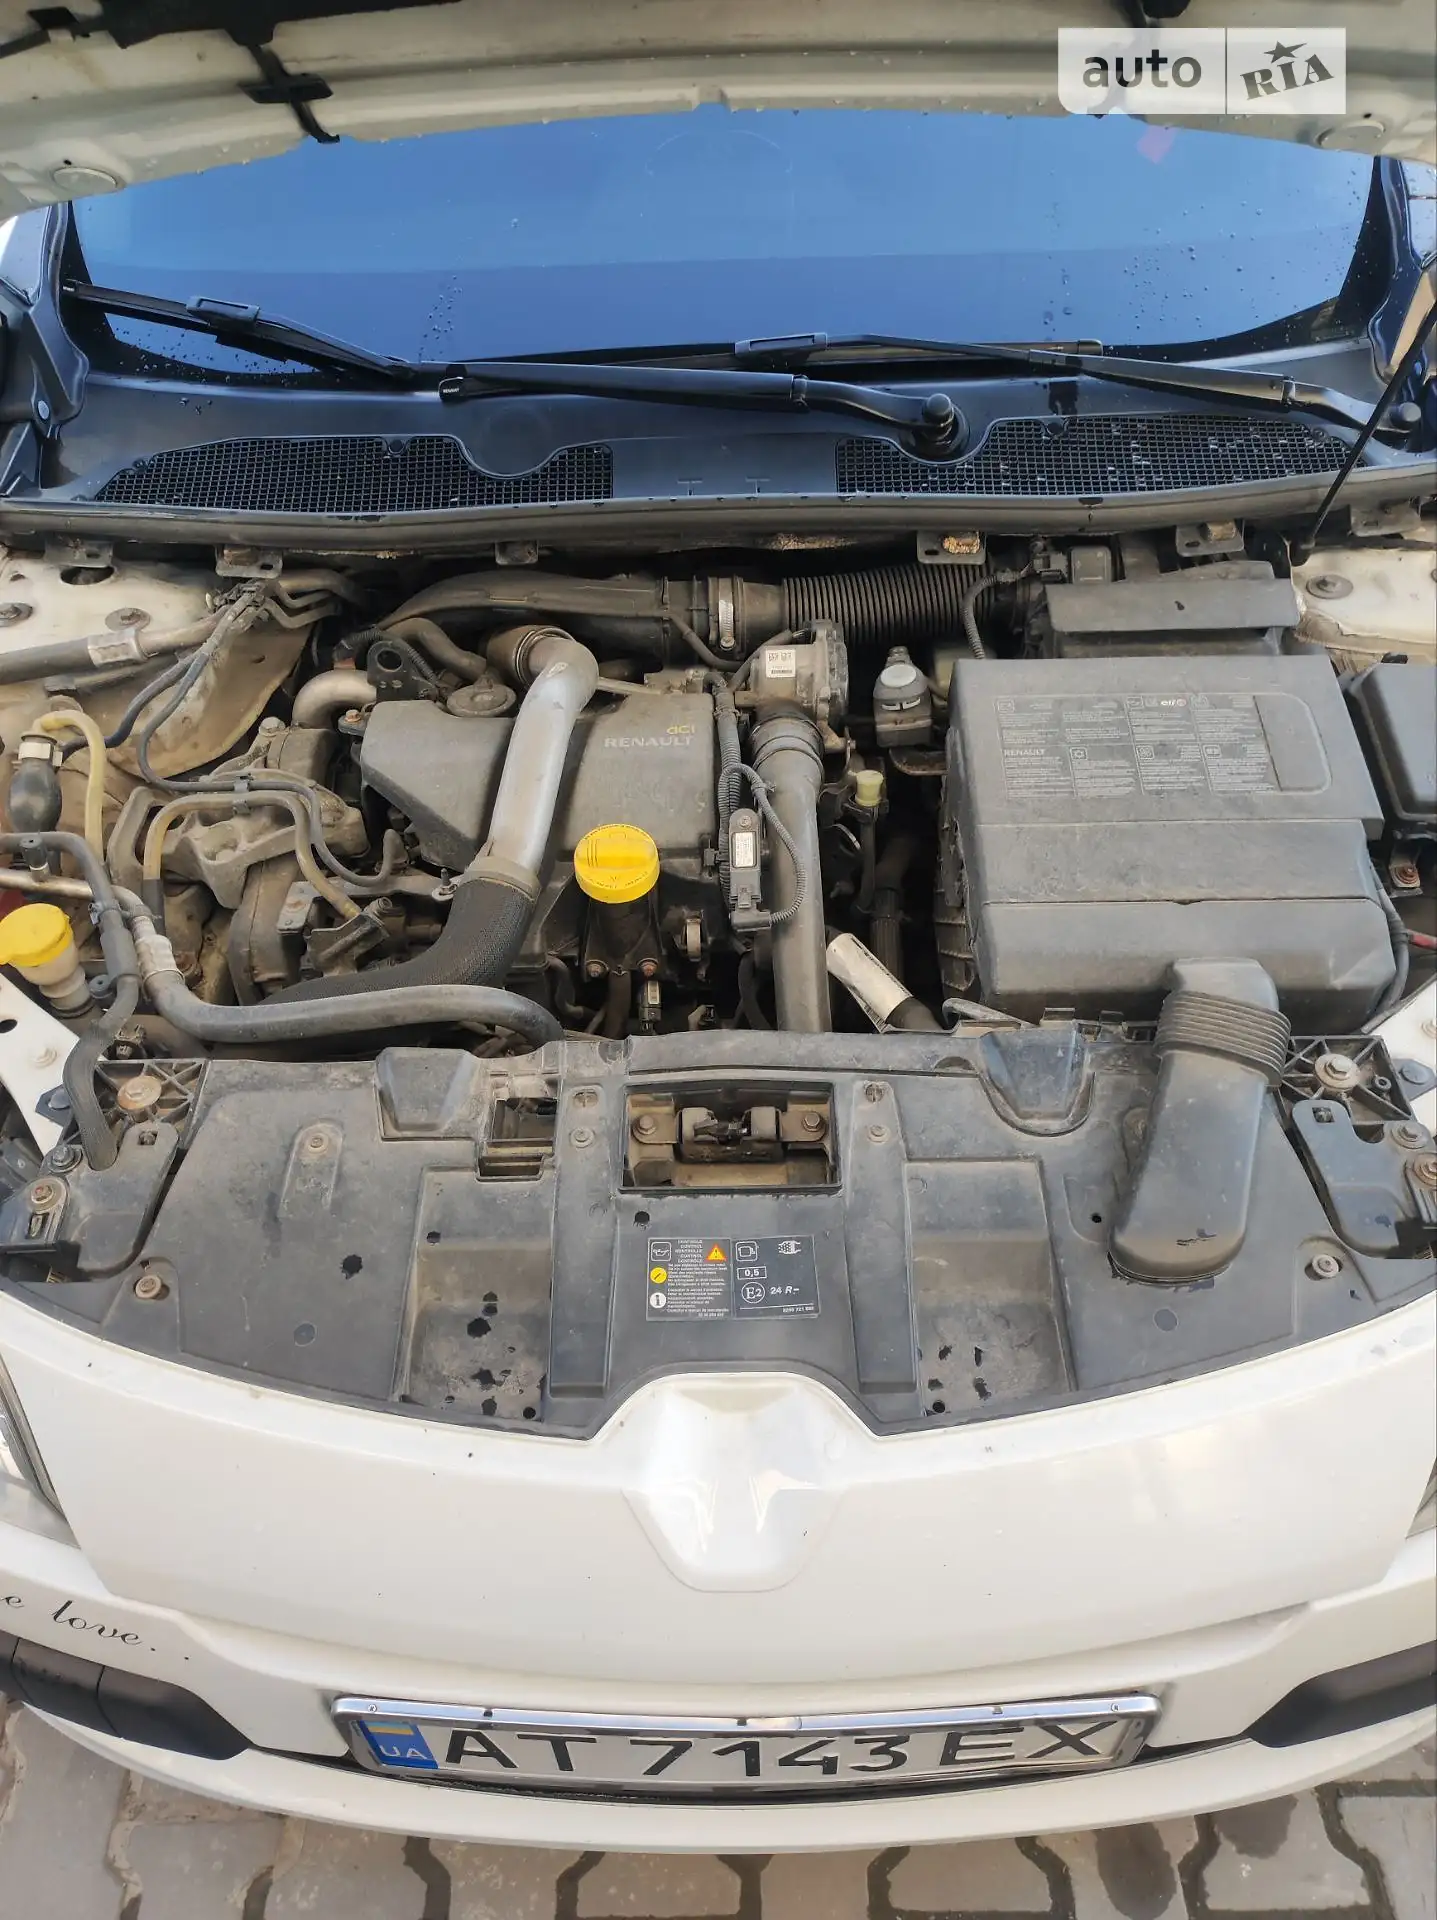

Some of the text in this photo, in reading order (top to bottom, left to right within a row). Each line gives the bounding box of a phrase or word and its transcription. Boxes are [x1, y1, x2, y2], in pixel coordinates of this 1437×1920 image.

[1160, 699, 1177, 707] elf
[604, 735, 694, 748] RENAULT
[744, 1268, 760, 1278] 0,5
[745, 1286, 763, 1300] E2
[770, 1286, 783, 1295] 24
[379, 1744, 428, 1760] UA
[445, 1720, 1119, 1778] AT 7143 EX
